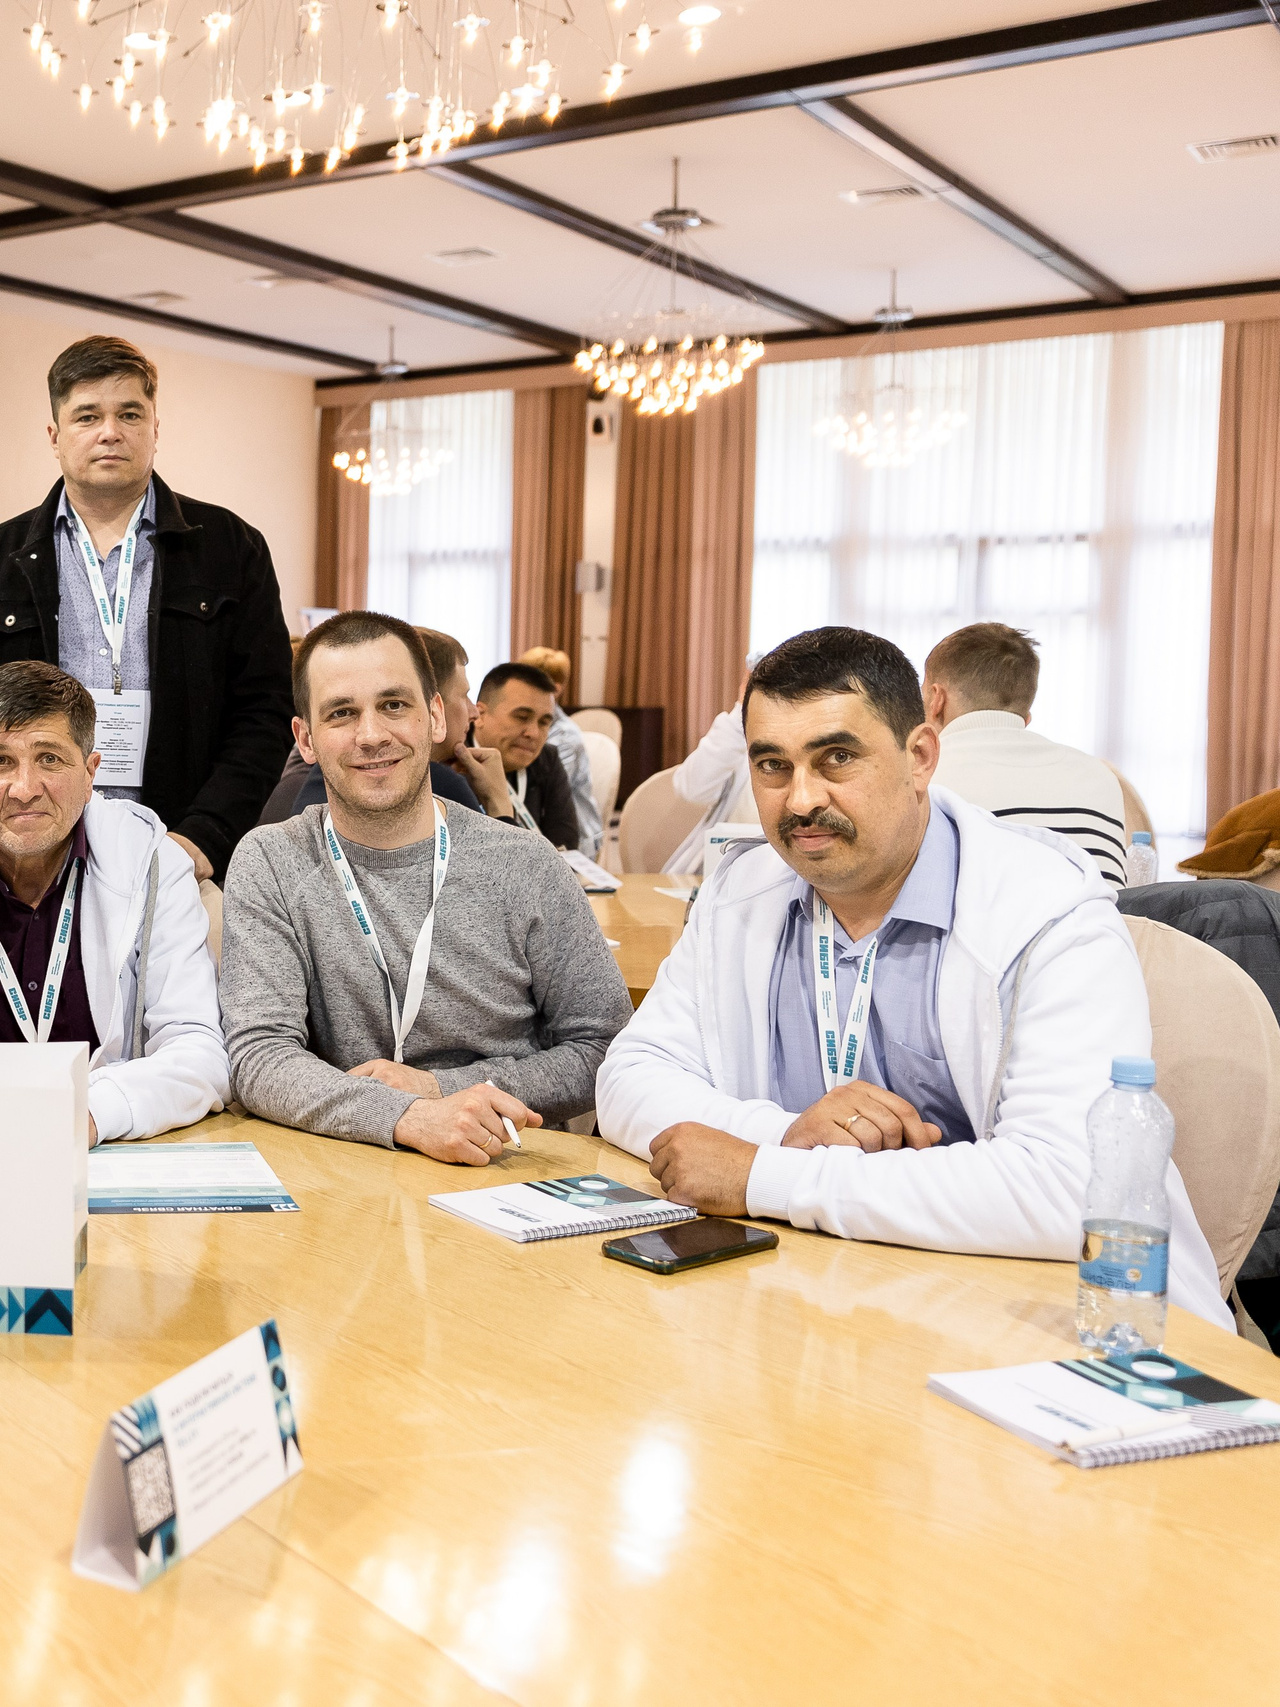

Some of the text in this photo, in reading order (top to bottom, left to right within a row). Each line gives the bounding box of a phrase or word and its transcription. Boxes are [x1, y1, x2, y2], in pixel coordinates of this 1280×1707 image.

[83, 541, 96, 567] СИБУР
[124, 537, 133, 564] СИБУР
[99, 597, 111, 626] СИБУР
[117, 595, 125, 625] СИБУР
[327, 828, 342, 861] СИБУР
[439, 825, 447, 861] СИБУР
[58, 908, 72, 944] СИБУР
[351, 900, 371, 936] СИБУР
[819, 935, 830, 979] СИБУР
[8, 987, 28, 1022] СИБУР
[42, 984, 56, 1020] СИБУР
[825, 1030, 838, 1075] СИБУР
[843, 1033, 858, 1078] СИБУР
